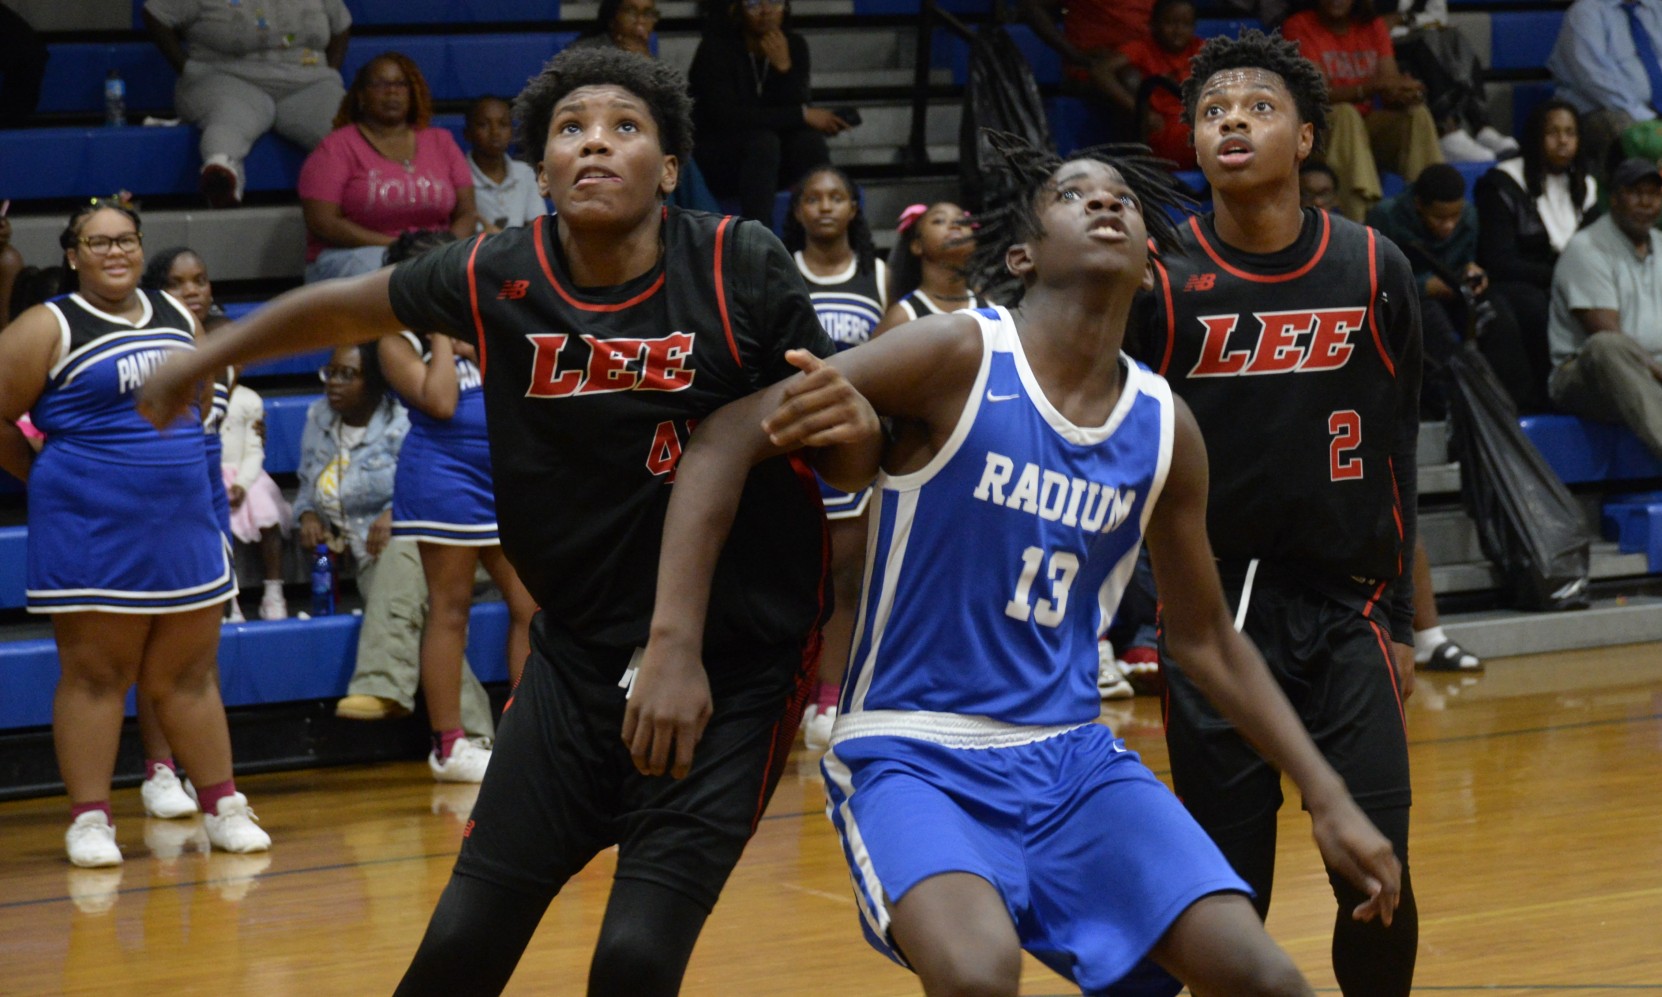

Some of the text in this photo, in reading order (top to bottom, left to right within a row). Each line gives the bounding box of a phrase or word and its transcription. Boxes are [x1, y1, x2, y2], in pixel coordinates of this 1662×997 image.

[817, 312, 870, 344] THERS
[1186, 306, 1367, 379] LEE
[116, 350, 172, 394] PANT
[525, 331, 696, 398] LEE
[646, 419, 699, 484] 4
[1328, 409, 1364, 482] 2
[973, 451, 1137, 534] RADIUM
[1005, 546, 1080, 628] 13
